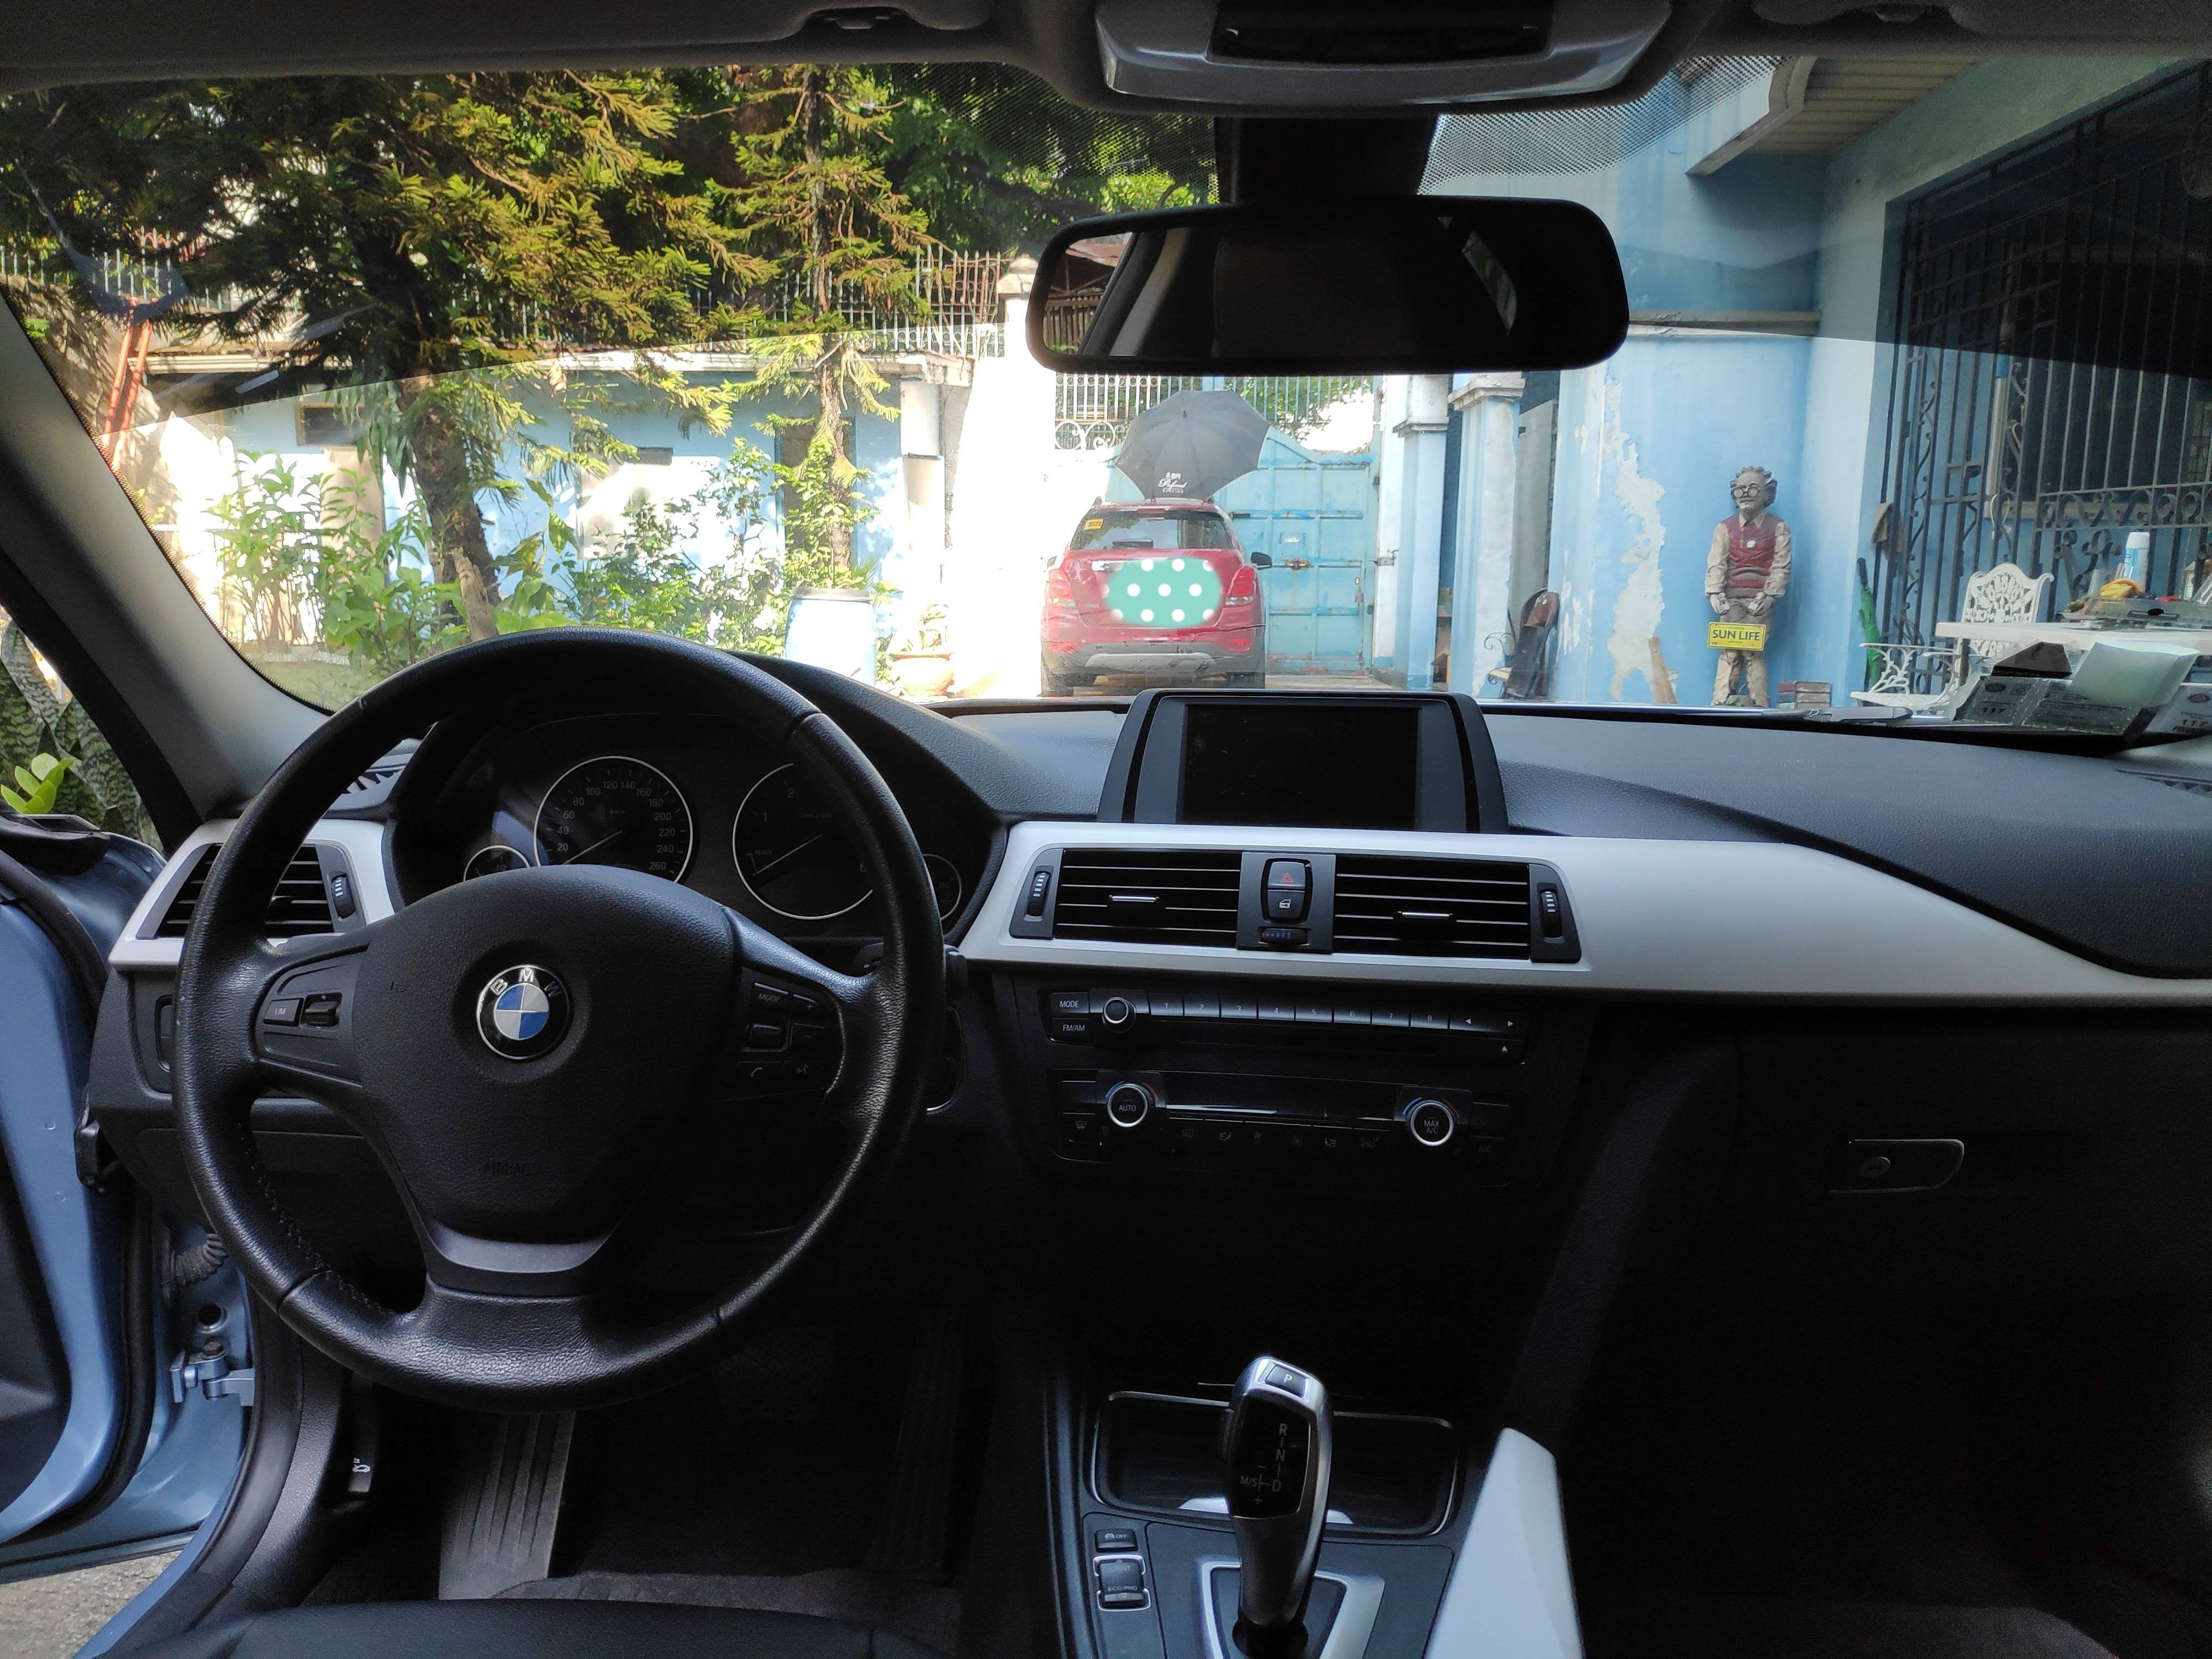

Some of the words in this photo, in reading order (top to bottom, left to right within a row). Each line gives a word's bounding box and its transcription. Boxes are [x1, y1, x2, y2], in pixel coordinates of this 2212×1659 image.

[1712, 629, 1736, 640] SUN
[1739, 630, 1760, 641] LIFE
[603, 781, 618, 789] 120
[621, 781, 636, 789] 140
[585, 787, 601, 796] 100
[636, 788, 651, 796] 160
[787, 788, 794, 799] 2
[573, 797, 584, 806] 80
[648, 798, 664, 807] 180
[563, 810, 574, 819] 60
[654, 812, 672, 821] 200
[763, 812, 768, 823] 1
[557, 826, 569, 835] 40
[658, 828, 676, 837] 220
[557, 843, 568, 851] 20
[657, 845, 674, 853] 240
[649, 861, 667, 870] 260
[859, 863, 866, 873] 6
[490, 967, 563, 997] BMW
[759, 993, 781, 1003] MODE
[1284, 1374, 1293, 1383] P
[1279, 1423, 1288, 1436] R
[1276, 1448, 1285, 1462] N
[1240, 1475, 1257, 1487] M/S
[1272, 1479, 1282, 1492] D
